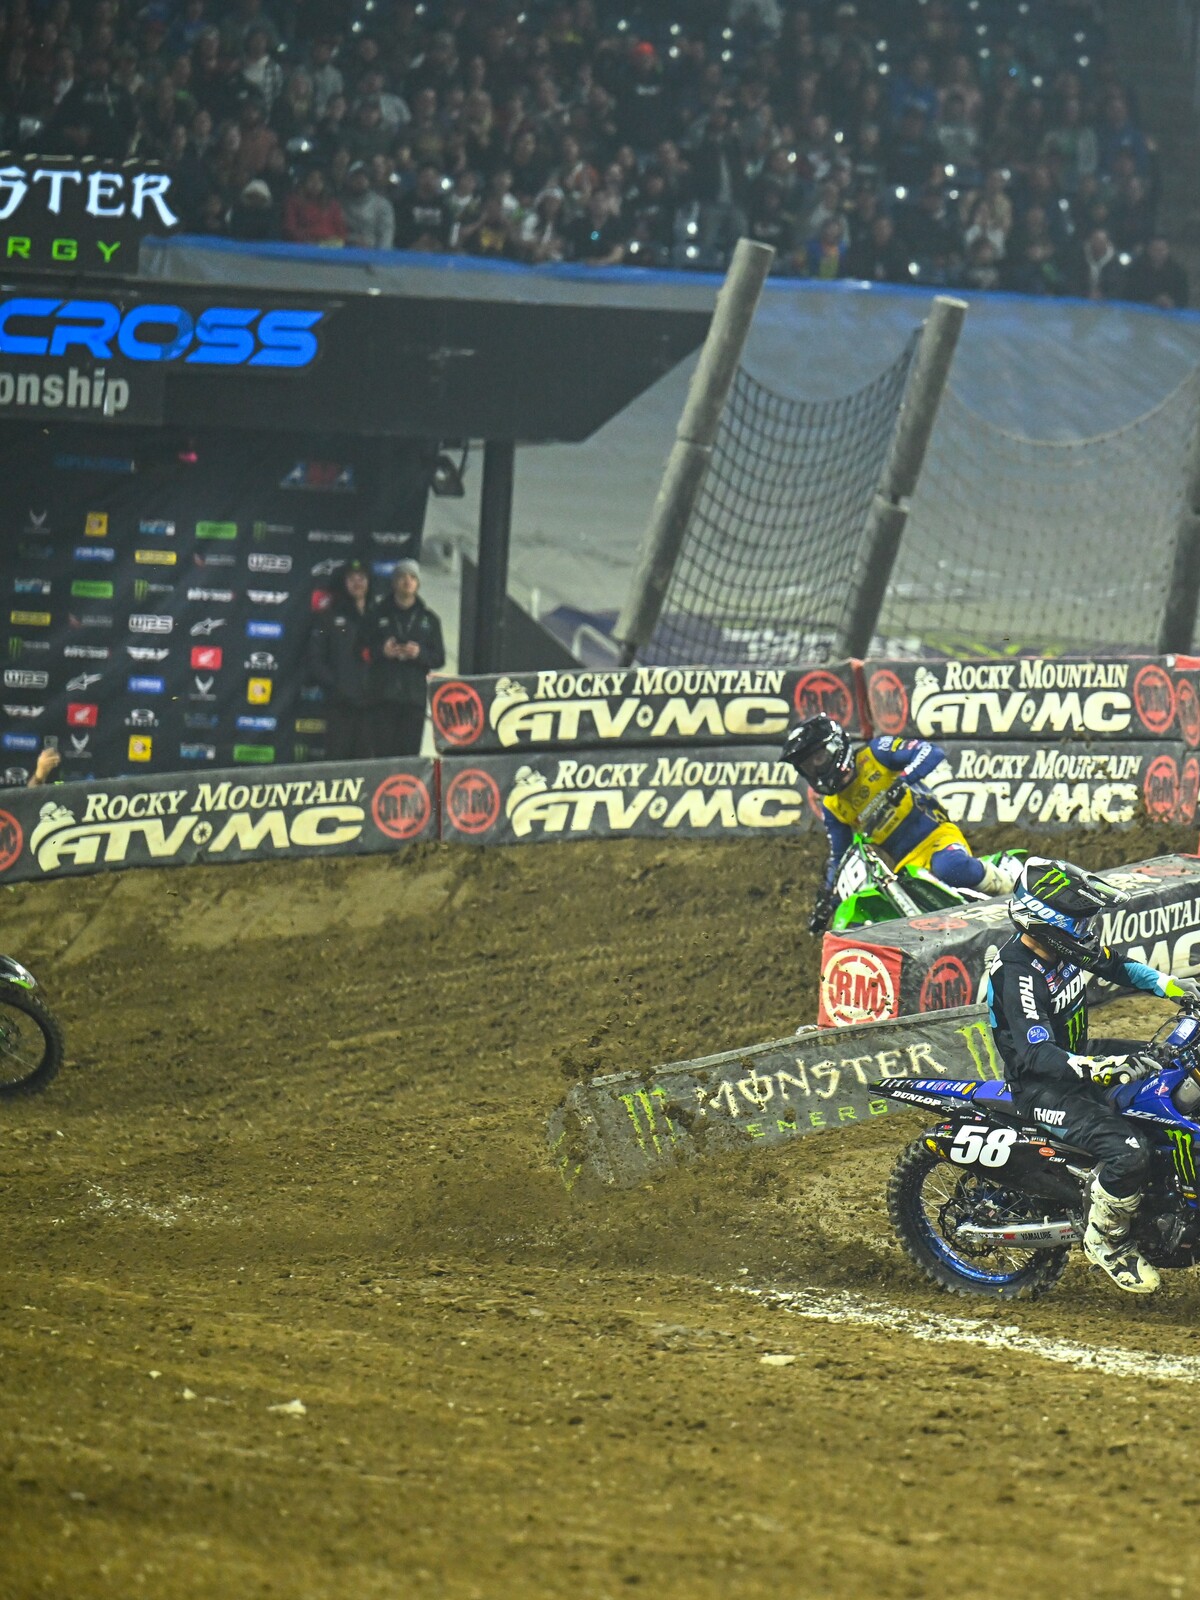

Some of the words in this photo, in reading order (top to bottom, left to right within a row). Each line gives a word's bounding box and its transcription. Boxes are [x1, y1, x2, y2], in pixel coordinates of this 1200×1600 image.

[0, 298, 325, 368] CROSS
[534, 670, 628, 700] ROCKY
[631, 668, 786, 696] MOUNTAIN
[943, 662, 1015, 691] ROCKY
[1019, 660, 1128, 690] MOUNTAIN
[552, 760, 645, 789] ROCKY
[650, 757, 800, 786] MOUNTAIN
[956, 751, 1034, 780] ROCKY
[82, 789, 188, 822] ROCKY
[191, 777, 364, 812] MOUNTAIN
[838, 971, 882, 1004] RM
[892, 1090, 943, 1106] DUNLOP
[746, 1099, 912, 1138] ENERG
[1034, 1108, 1067, 1126] THOR
[950, 1125, 1017, 1168] 58
